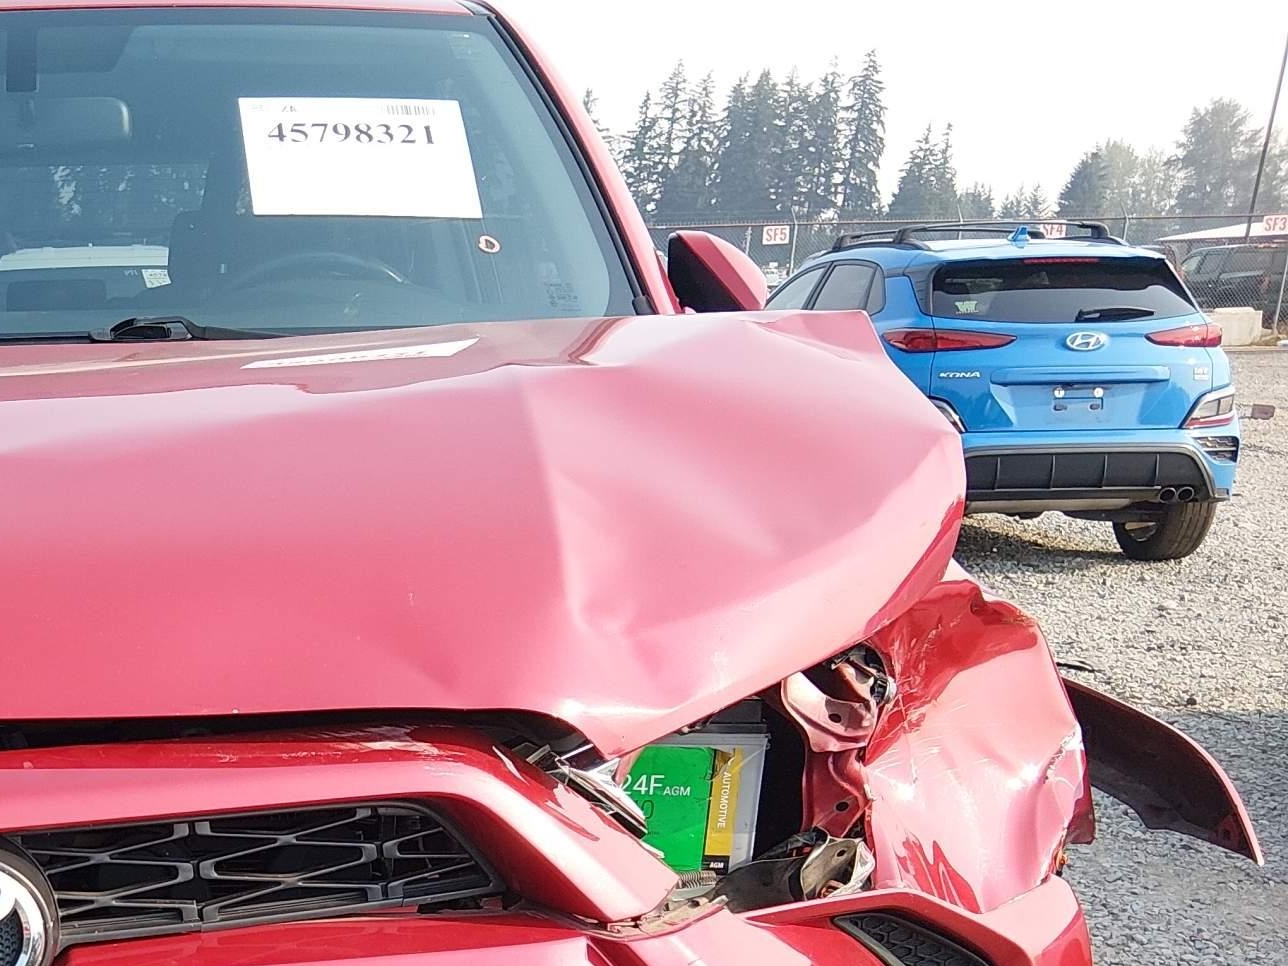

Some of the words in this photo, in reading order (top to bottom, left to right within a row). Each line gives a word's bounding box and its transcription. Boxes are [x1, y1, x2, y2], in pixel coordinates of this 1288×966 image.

[267, 122, 435, 145] 45798321
[1264, 216, 1288, 231] SF3
[765, 227, 788, 242] SF5
[939, 370, 981, 378] KONA
[620, 774, 665, 795] 24F
[663, 786, 691, 796] AGM
[717, 771, 732, 829] AUTOMOTIVE
[709, 861, 724, 869] AGM
